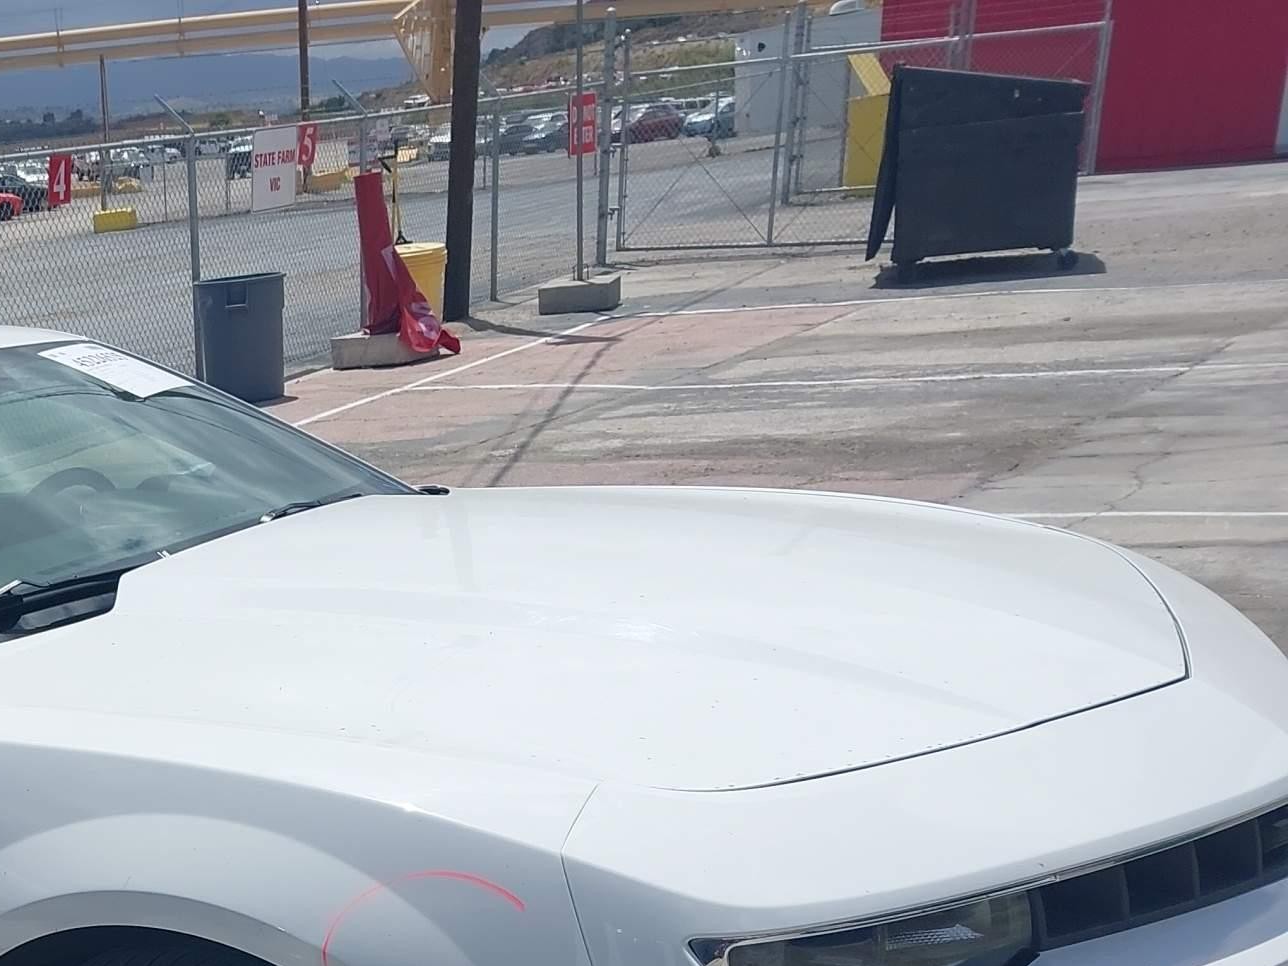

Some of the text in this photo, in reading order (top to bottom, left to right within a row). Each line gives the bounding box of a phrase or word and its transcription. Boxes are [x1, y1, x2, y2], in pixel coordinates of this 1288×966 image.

[302, 126, 315, 162] 5
[254, 149, 296, 169] STATE FARM
[53, 159, 66, 200] 4
[269, 176, 281, 193] VIC
